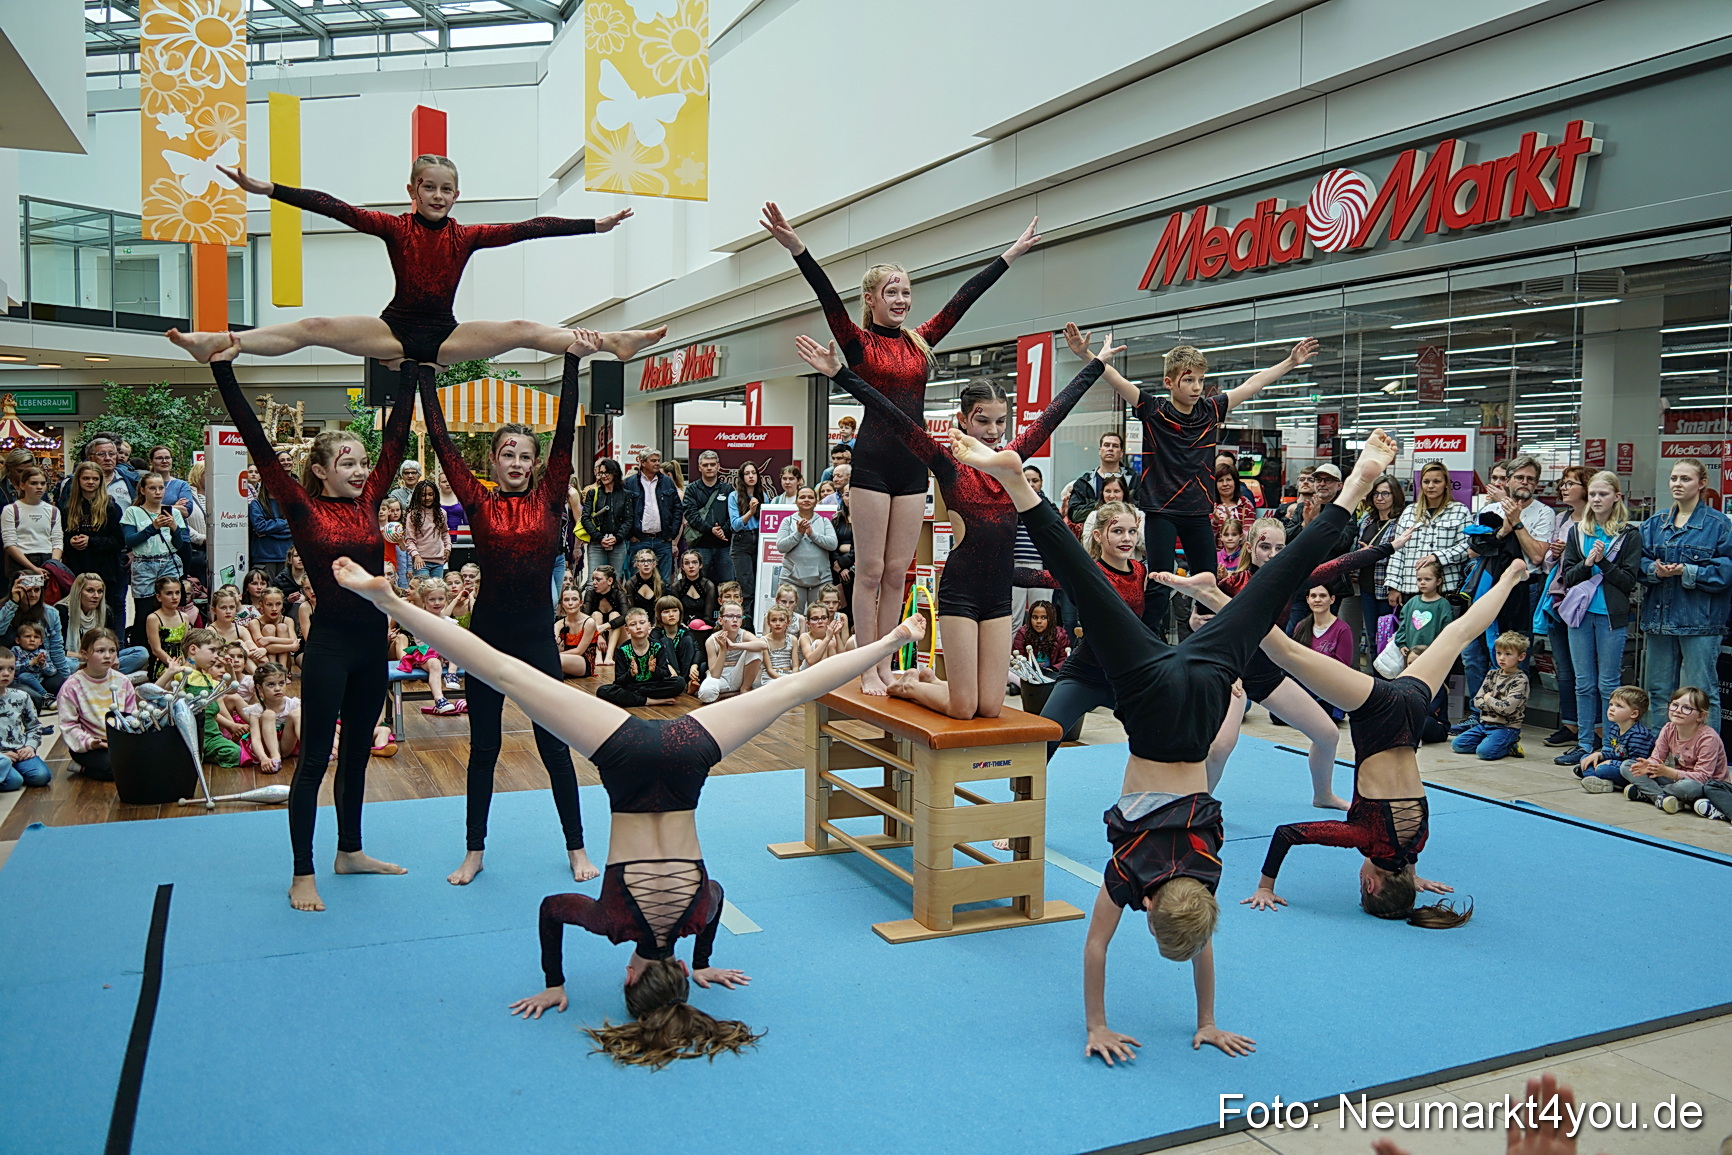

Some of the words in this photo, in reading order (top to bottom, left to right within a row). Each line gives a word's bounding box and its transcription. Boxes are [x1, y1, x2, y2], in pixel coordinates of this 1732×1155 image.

[1137, 197, 1314, 291] Media
[1350, 119, 1603, 249] Markt
[639, 355, 674, 391] Media
[679, 343, 720, 383] Markt
[1026, 342, 1044, 404] 1
[19, 399, 69, 407] LEBENSRAUM
[222, 434, 245, 444] Med
[714, 432, 740, 441] Media
[744, 432, 768, 441] Markt
[1430, 438, 1462, 450] Markt
[1664, 443, 1701, 456] Media
[764, 514, 779, 530] T
